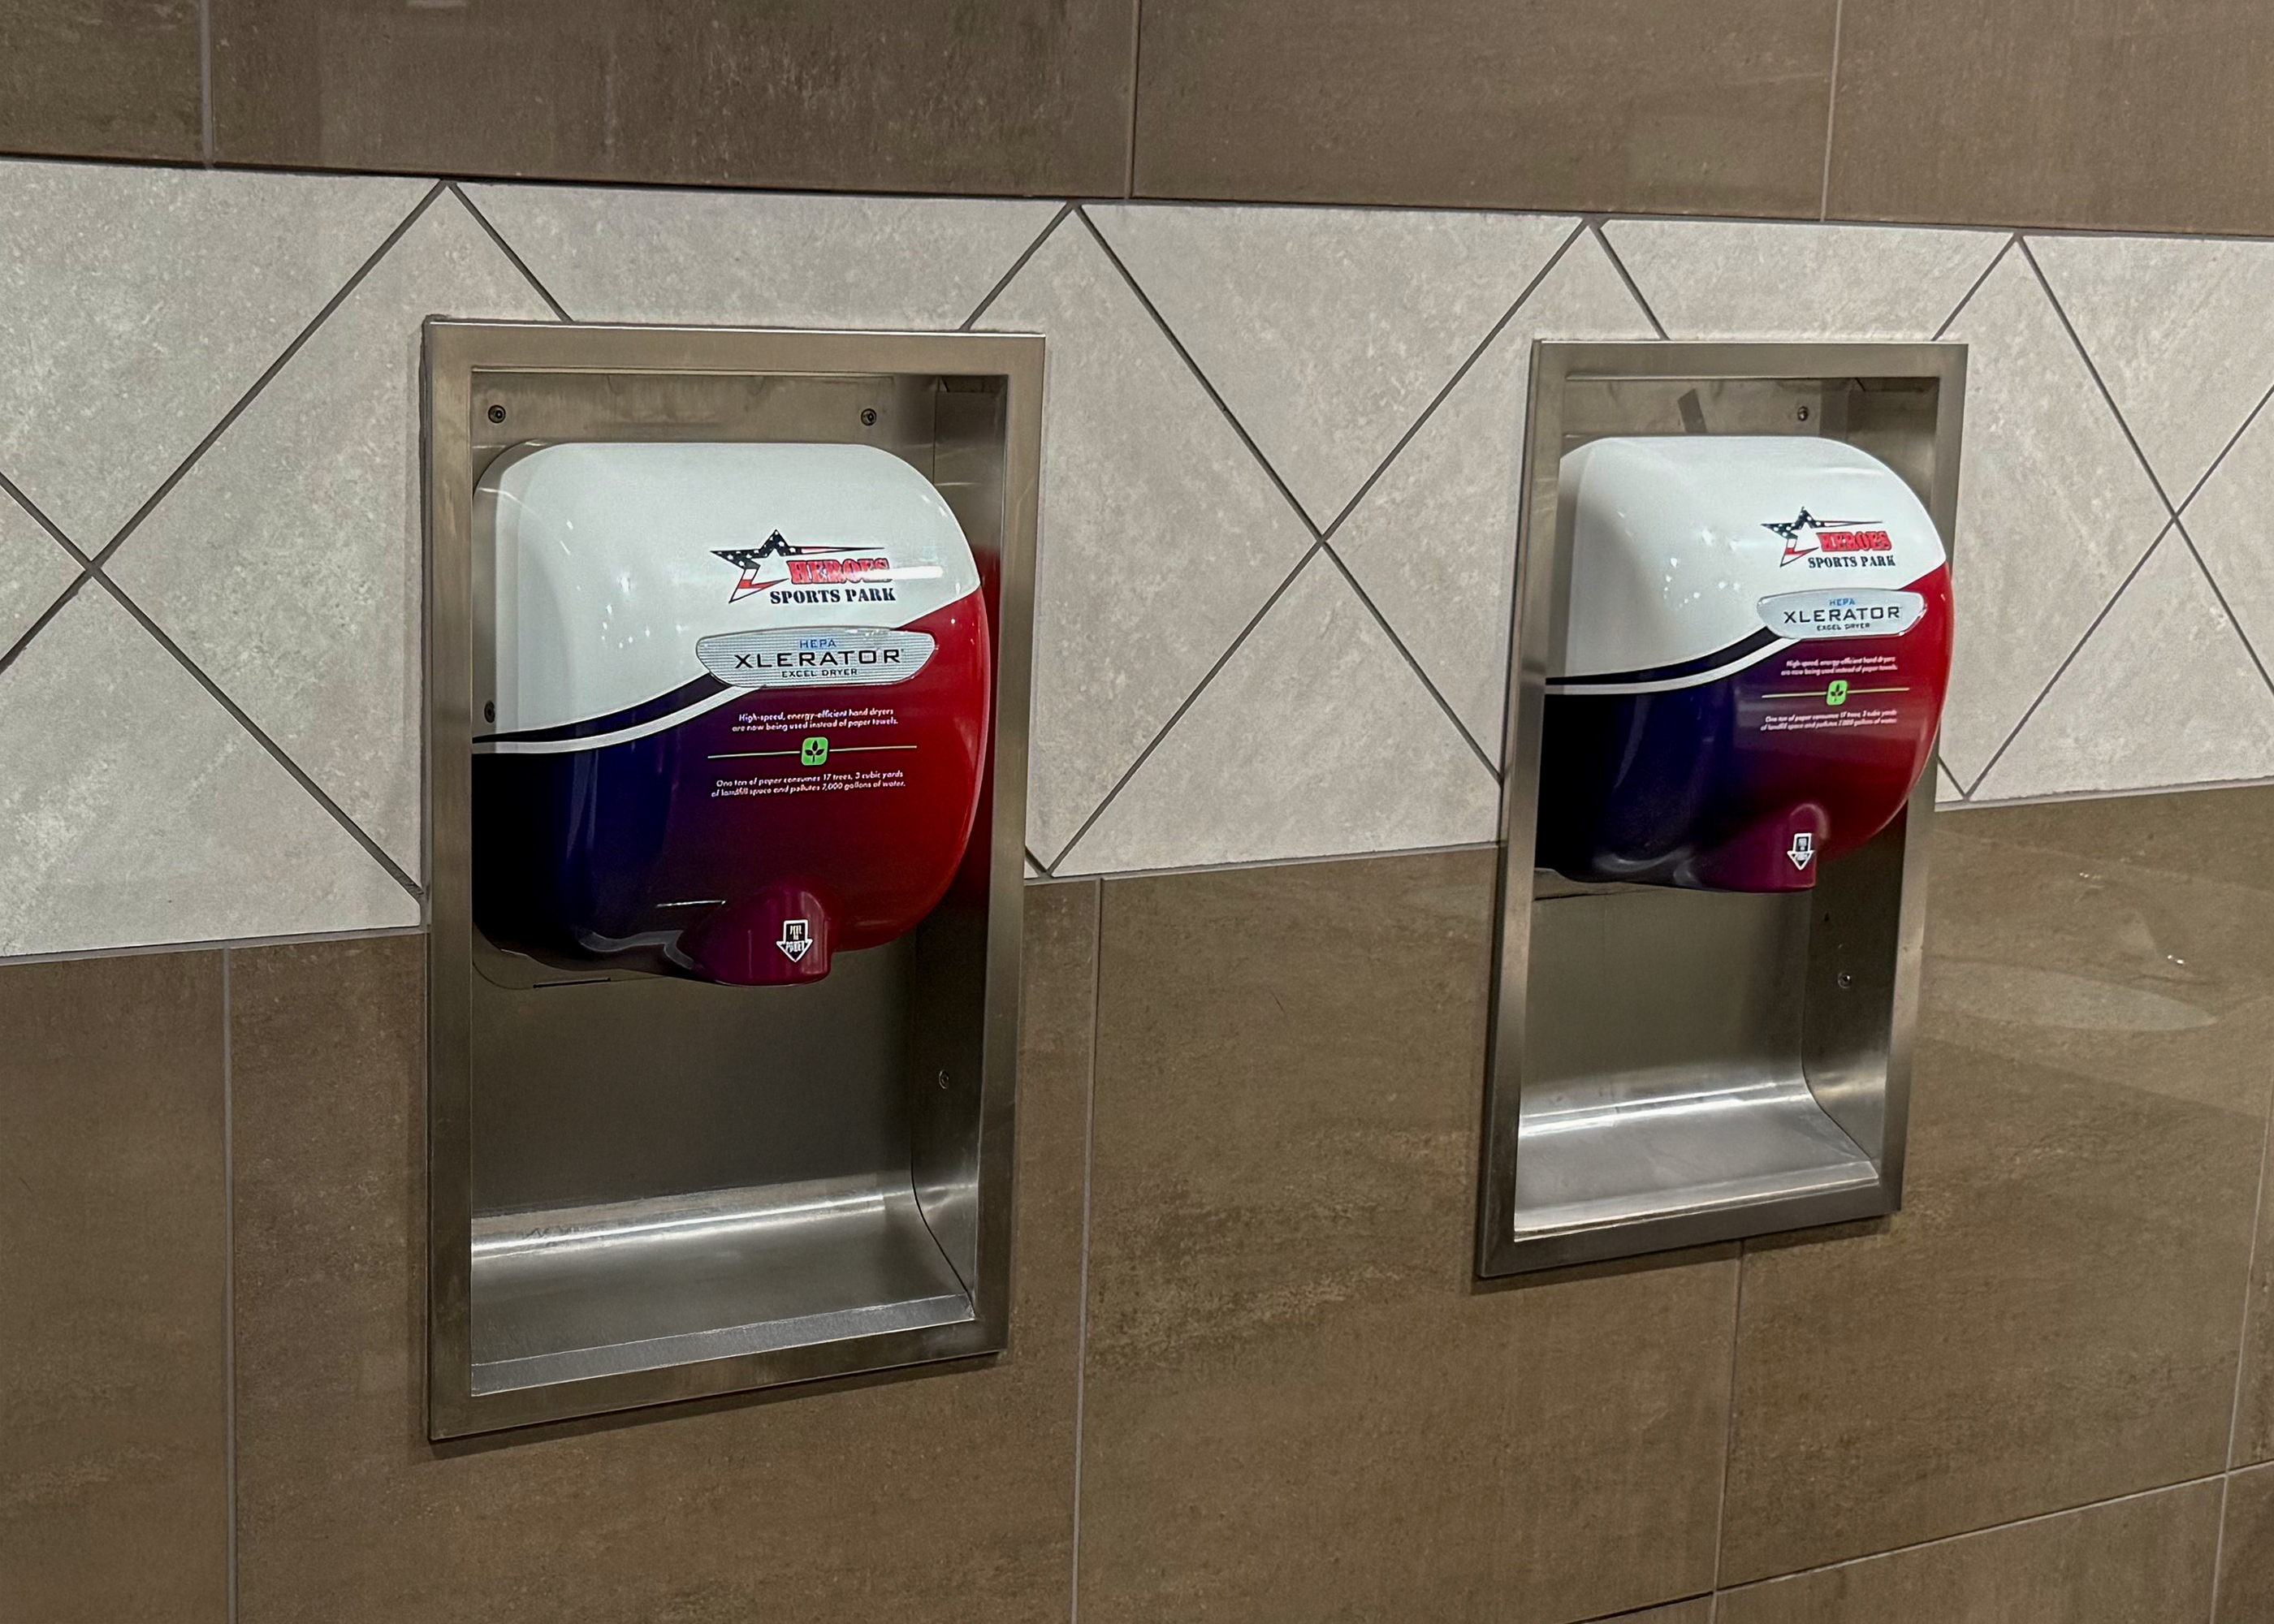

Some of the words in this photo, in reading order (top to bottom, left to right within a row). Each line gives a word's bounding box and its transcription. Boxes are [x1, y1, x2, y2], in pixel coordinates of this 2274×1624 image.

[1816, 530, 1892, 552] HEROES
[1808, 556, 1857, 568] SPORTS
[1860, 555, 1896, 567] PARK
[786, 558, 893, 585] HEROES
[770, 589, 841, 604] SPORTS
[845, 588, 896, 602] PARK
[1829, 598, 1856, 607] HEPA
[1783, 607, 1900, 624] XLERATOR
[799, 639, 837, 649] HEPA
[735, 649, 901, 669] XLERATOR
[781, 670, 815, 678] EXCEL
[822, 668, 858, 676] DRYER
[738, 712, 786, 723] High-speed,
[787, 710, 847, 722] energy-efficient
[848, 707, 868, 717] hand
[869, 707, 894, 717] dryers
[766, 722, 789, 732] being
[789, 720, 808, 730] used
[810, 719, 838, 729] instead
[838, 718, 847, 728] of
[848, 719, 871, 729] paper
[749, 777, 758, 786] of
[759, 778, 783, 787] paper
[854, 771, 861, 780] 3
[862, 770, 881, 779] cubic
[882, 770, 904, 780] yards
[711, 788, 720, 797] of
[773, 784, 789, 793] and
[822, 782, 844, 792] 7,000
[844, 781, 872, 791] gallons
[872, 780, 882, 788] of
